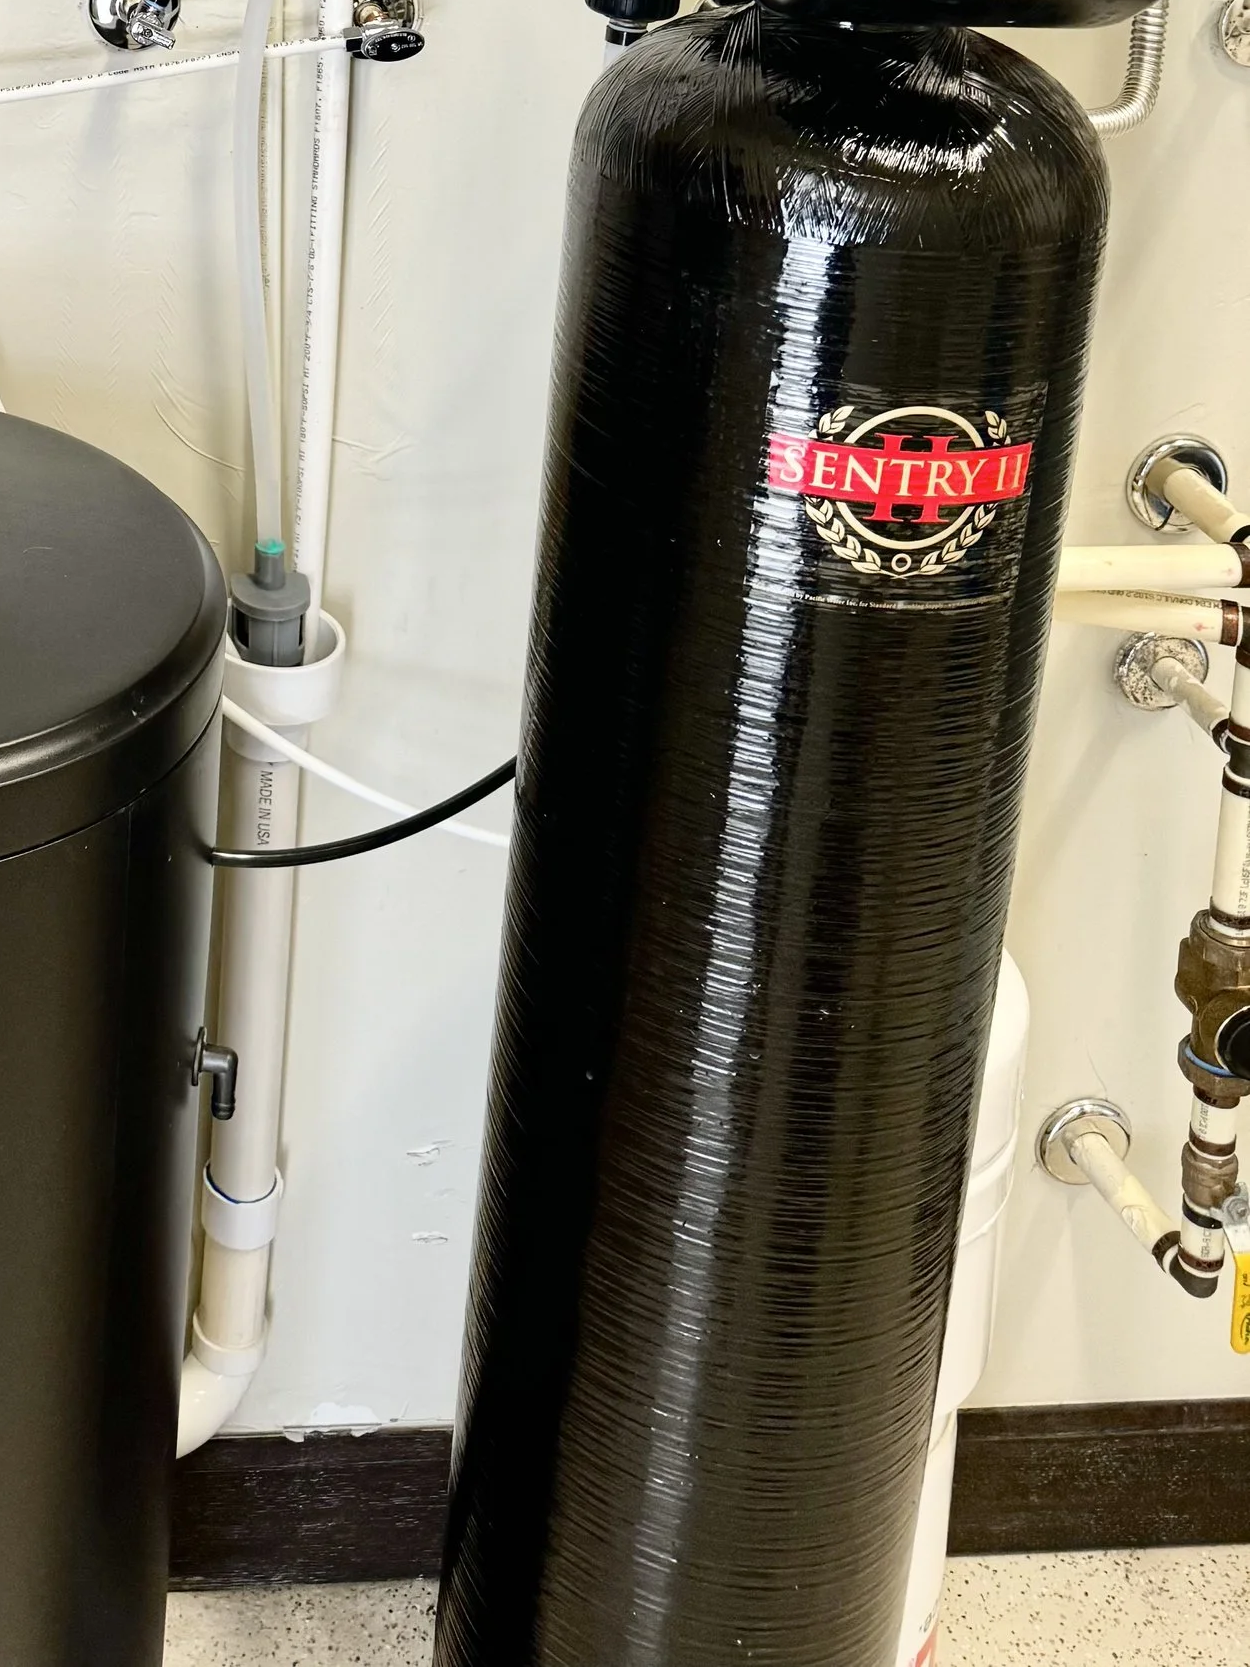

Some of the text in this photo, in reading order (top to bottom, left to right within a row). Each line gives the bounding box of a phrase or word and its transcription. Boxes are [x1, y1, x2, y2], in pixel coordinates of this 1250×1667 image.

[310, 137, 321, 191] STANDARDS
[779, 444, 1025, 498] SENTRY II
[257, 770, 274, 846] MADE IN USA
